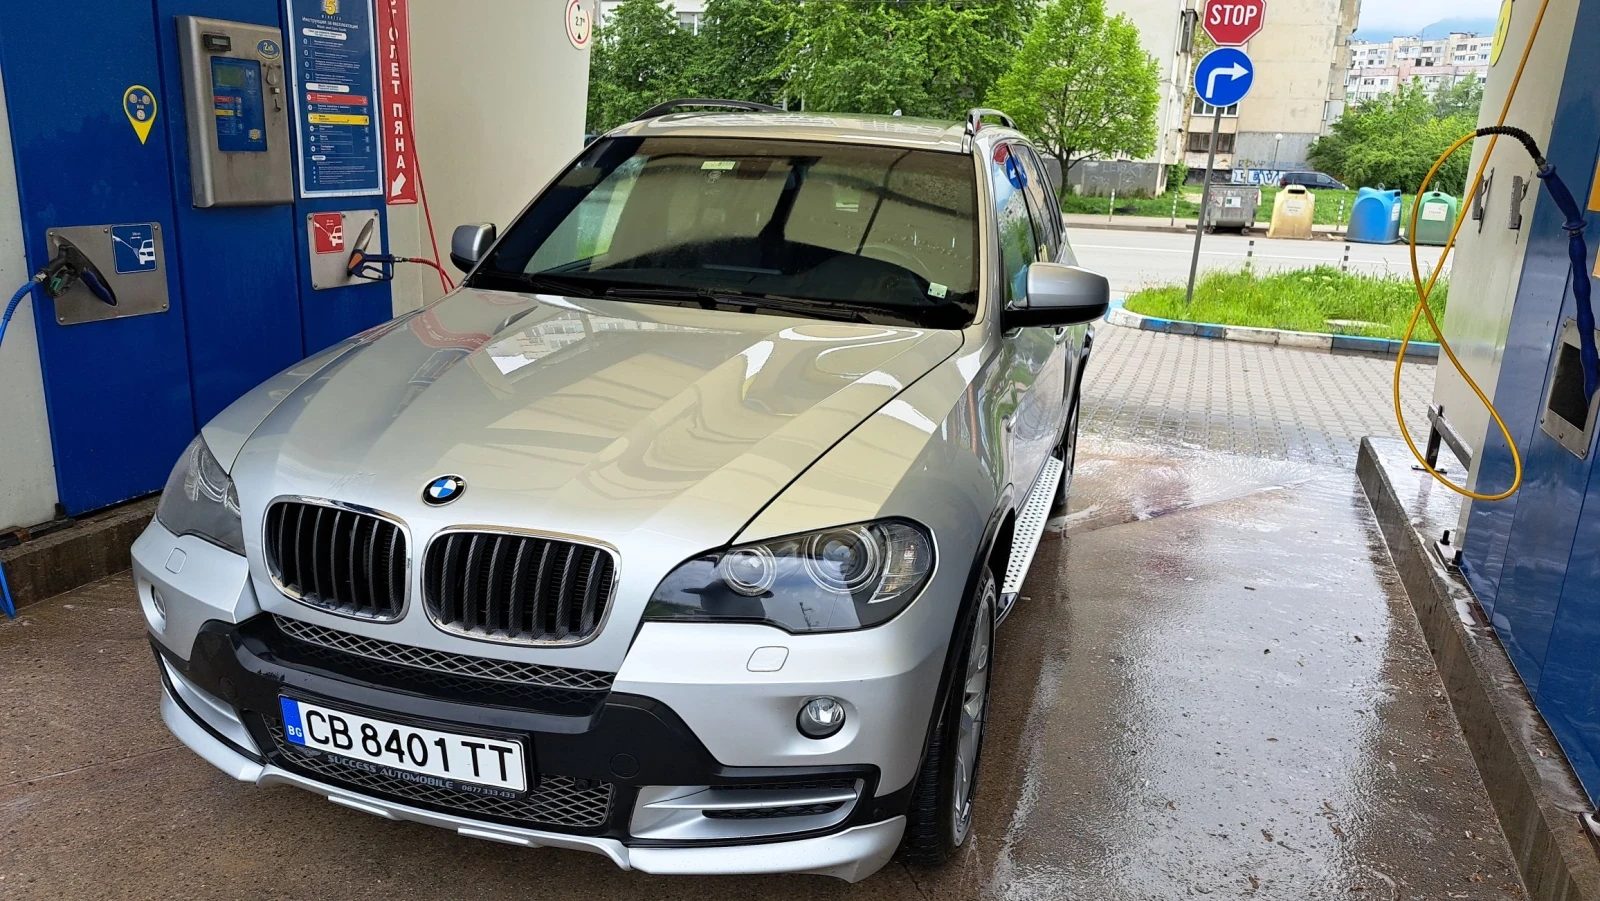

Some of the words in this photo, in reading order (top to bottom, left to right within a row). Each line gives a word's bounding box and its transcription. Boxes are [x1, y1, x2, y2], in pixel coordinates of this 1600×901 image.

[1210, 4, 1258, 26] STOP
[393, 103, 406, 169] ПЯНА
[287, 725, 303, 737] BG
[306, 710, 353, 750] CB
[360, 723, 450, 772] 8401
[461, 740, 513, 781] TT
[327, 754, 377, 773] SUCCESS
[380, 768, 454, 789] AUTOMOBILE
[461, 784, 482, 793] 0877
[482, 788, 498, 796] 333
[499, 791, 516, 799] 433
